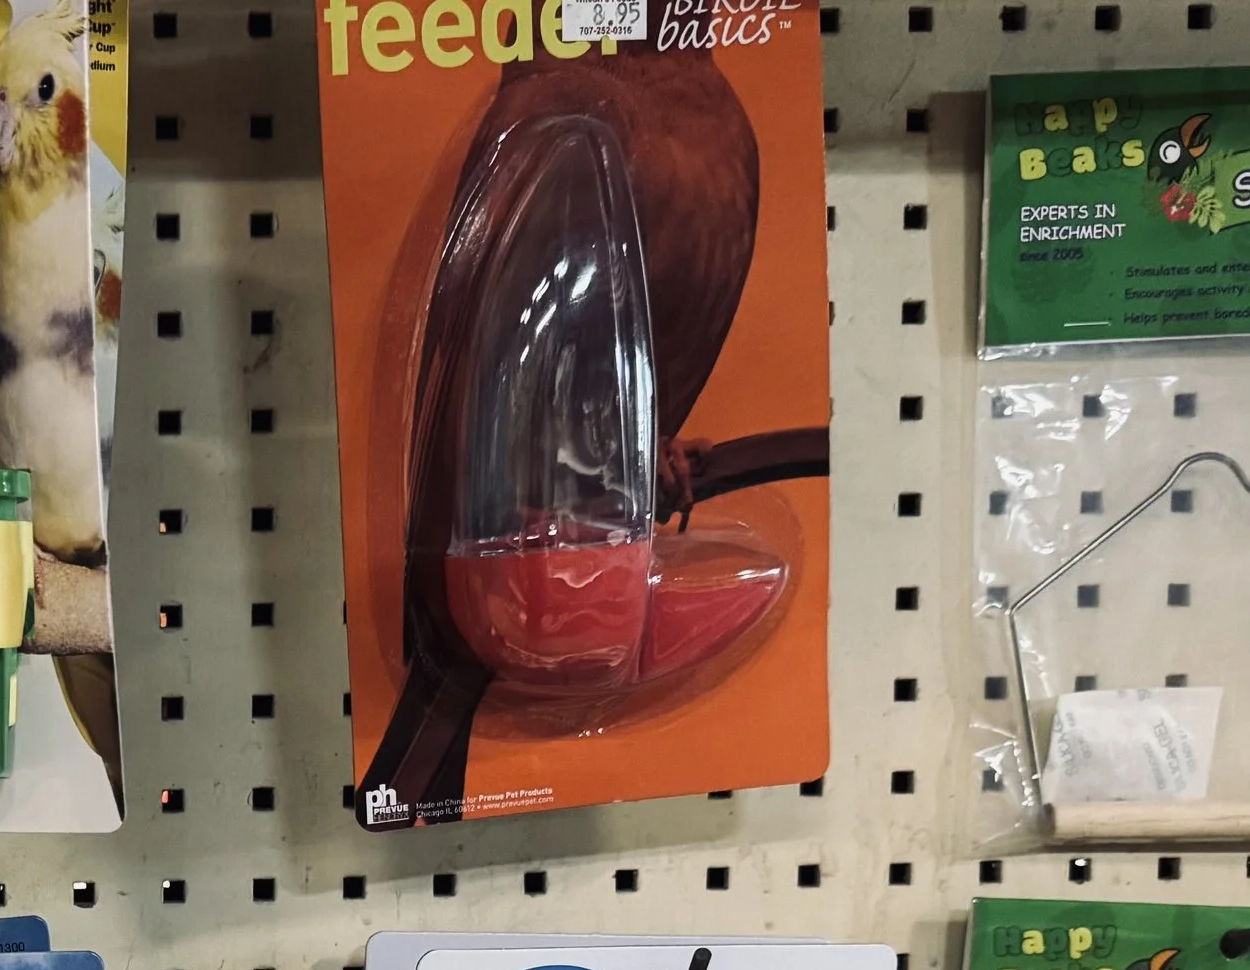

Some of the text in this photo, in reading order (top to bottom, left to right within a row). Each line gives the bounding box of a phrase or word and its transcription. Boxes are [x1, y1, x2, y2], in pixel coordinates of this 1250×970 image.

[592, 2, 640, 25] 8.95
[579, 26, 633, 36] 707-252-0316
[657, 2, 777, 52] basics
[324, 0, 617, 75] feede
[96, 42, 115, 55] Cup
[1019, 136, 1145, 181] Beaks
[1021, 204, 1116, 221] EXPERTS IN
[1021, 224, 1126, 242] ENRICHMENT
[416, 802, 435, 810] Made
[445, 799, 464, 807] China
[479, 794, 504, 803] Prevue
[506, 791, 518, 800] Pet
[520, 788, 553, 798] Products
[374, 805, 409, 814] PREVUE
[416, 808, 444, 818] Chicago
[993, 925, 1117, 960] Happy
